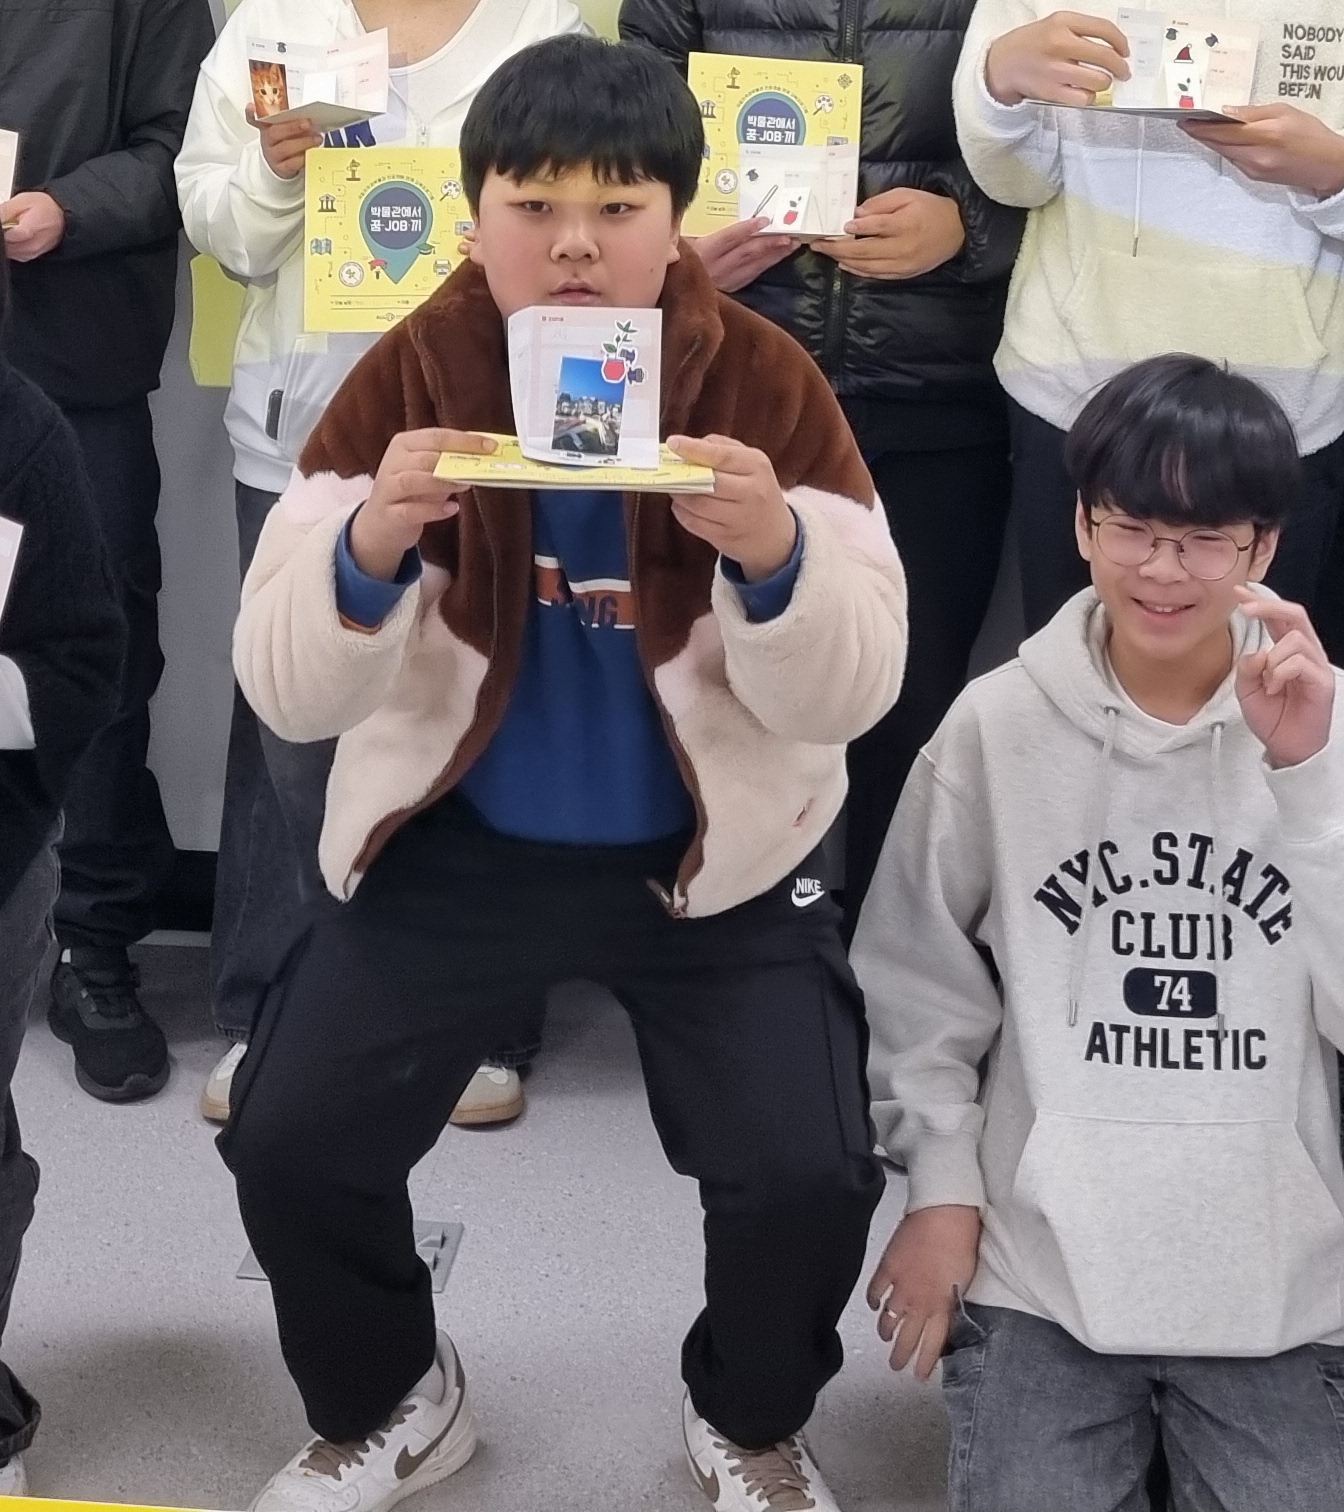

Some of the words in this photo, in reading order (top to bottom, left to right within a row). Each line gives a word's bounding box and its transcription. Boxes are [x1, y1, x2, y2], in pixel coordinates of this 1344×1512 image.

[1283, 23, 1344, 43] NOBODY
[1281, 44, 1316, 61] SAID
[1280, 63, 1311, 80] THIS
[747, 114, 796, 130] 박물관에서
[370, 206, 422, 218] 박물관에서
[796, 878, 821, 894] NIKE
[1112, 909, 1233, 960] CLUB
[1154, 976, 1192, 1011] 74
[1084, 1021, 1267, 1071] ATHLETIC
